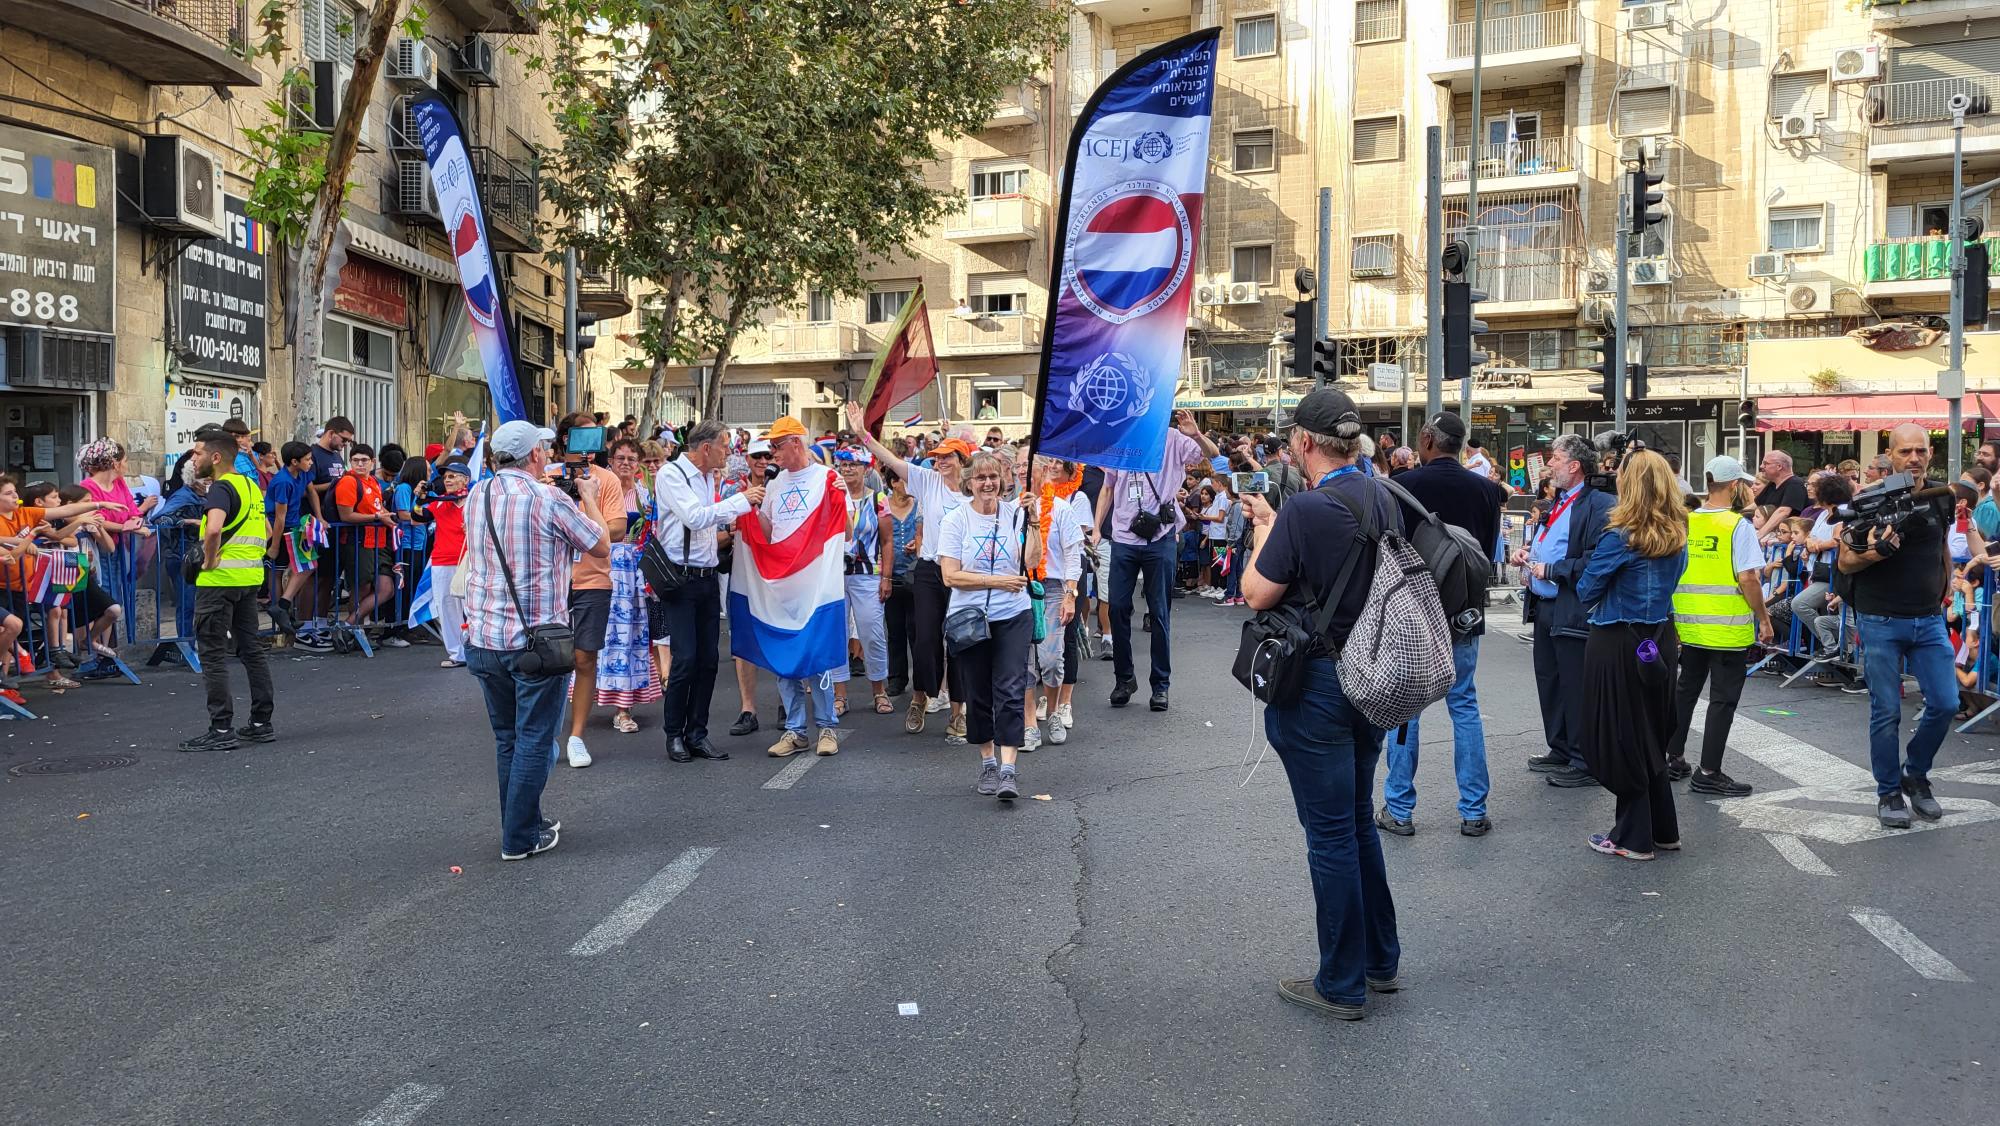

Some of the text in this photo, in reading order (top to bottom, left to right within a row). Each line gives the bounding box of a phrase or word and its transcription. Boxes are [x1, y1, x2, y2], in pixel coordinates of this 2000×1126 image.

[1086, 139, 1130, 163] ICEJ
[1126, 181, 1151, 189] הולנד
[36, 217, 96, 247] ראשי
[1069, 191, 1108, 249] NETHERLANDS
[33, 257, 67, 280] היבואן
[72, 263, 96, 283] חנות
[1147, 250, 1190, 310] NETHERLANDS
[0, 288, 79, 323] -888
[1068, 269, 1104, 315] NEDERLAND
[188, 334, 260, 367] 1700-501-888
[180, 383, 214, 399] colors
[1203, 399, 1249, 407] COMPUTERS
